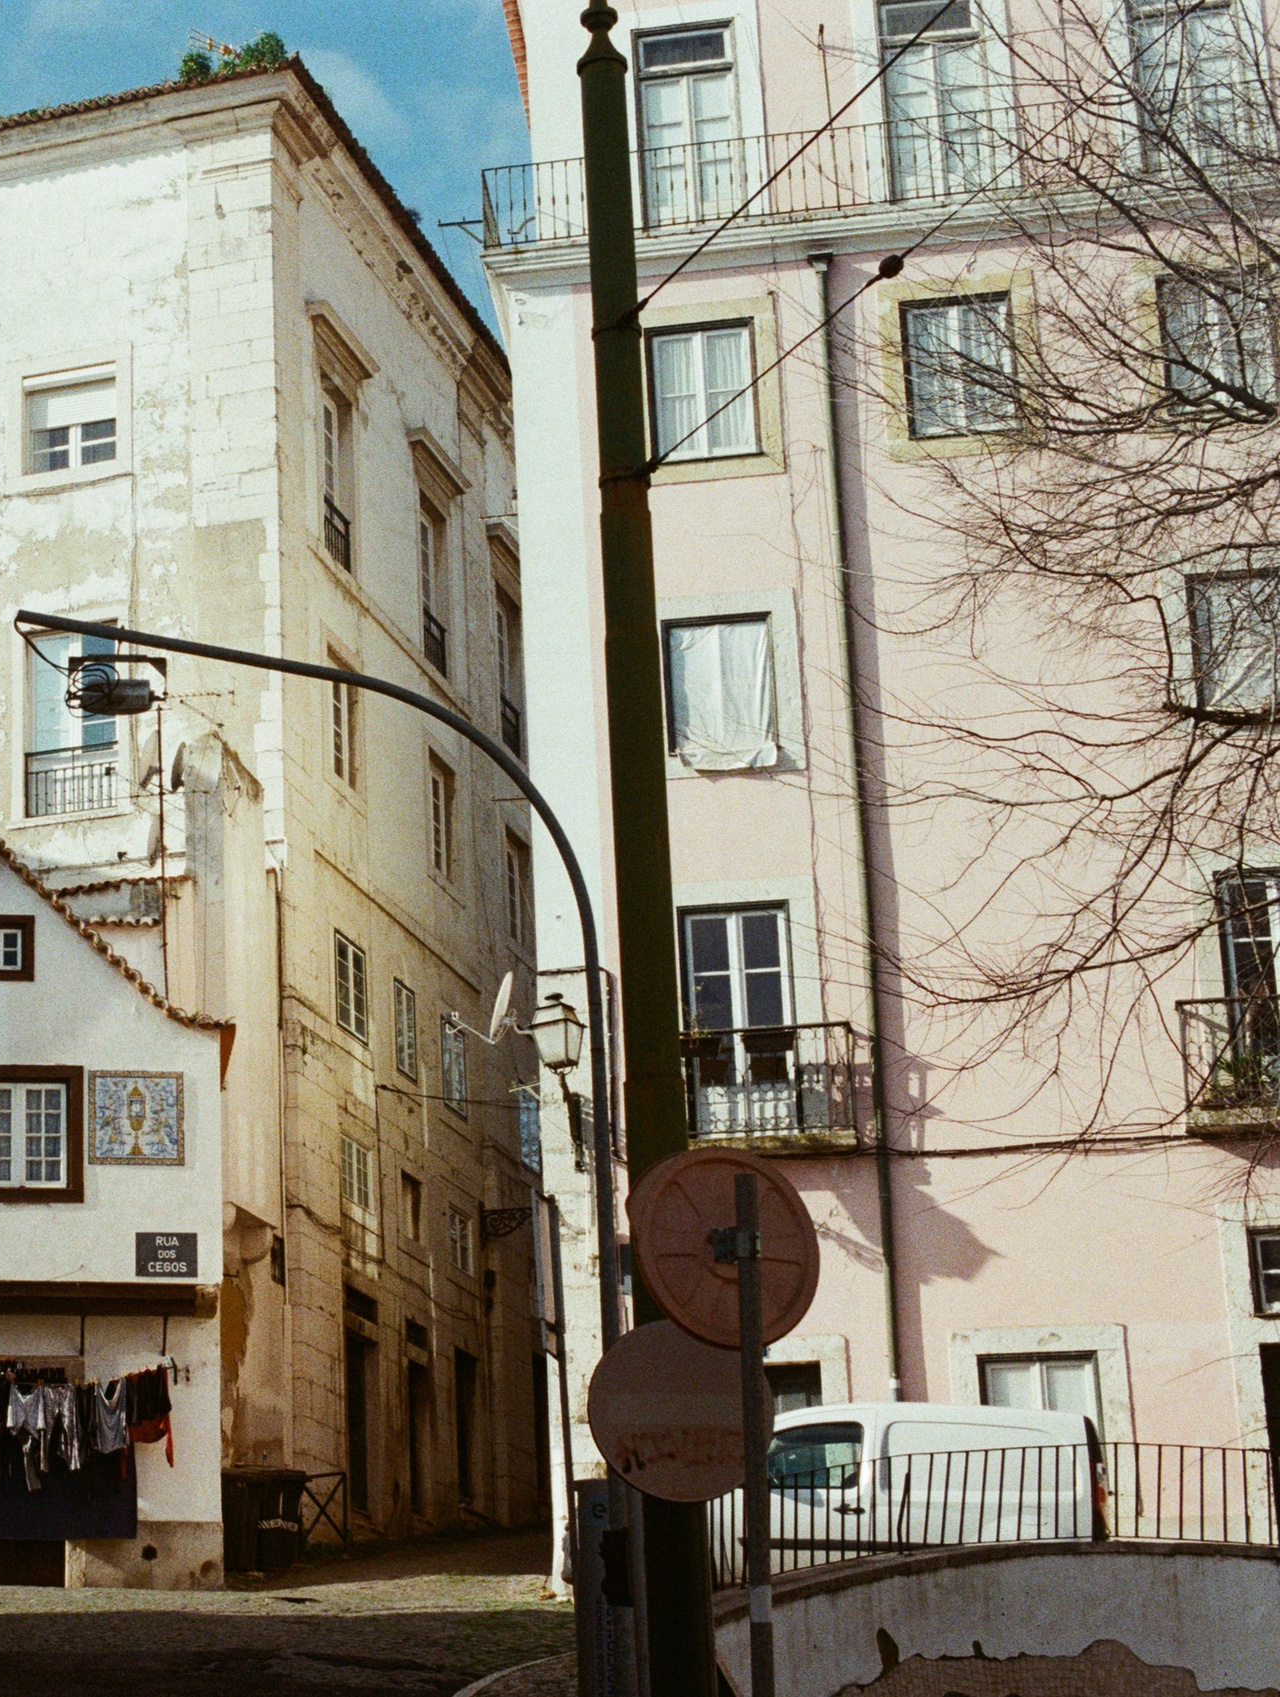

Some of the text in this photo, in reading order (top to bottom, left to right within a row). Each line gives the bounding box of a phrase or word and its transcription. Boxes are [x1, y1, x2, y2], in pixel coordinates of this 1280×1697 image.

[155, 1236, 179, 1247] RUA
[157, 1250, 177, 1259] DOS
[148, 1262, 187, 1273] CEGOS
